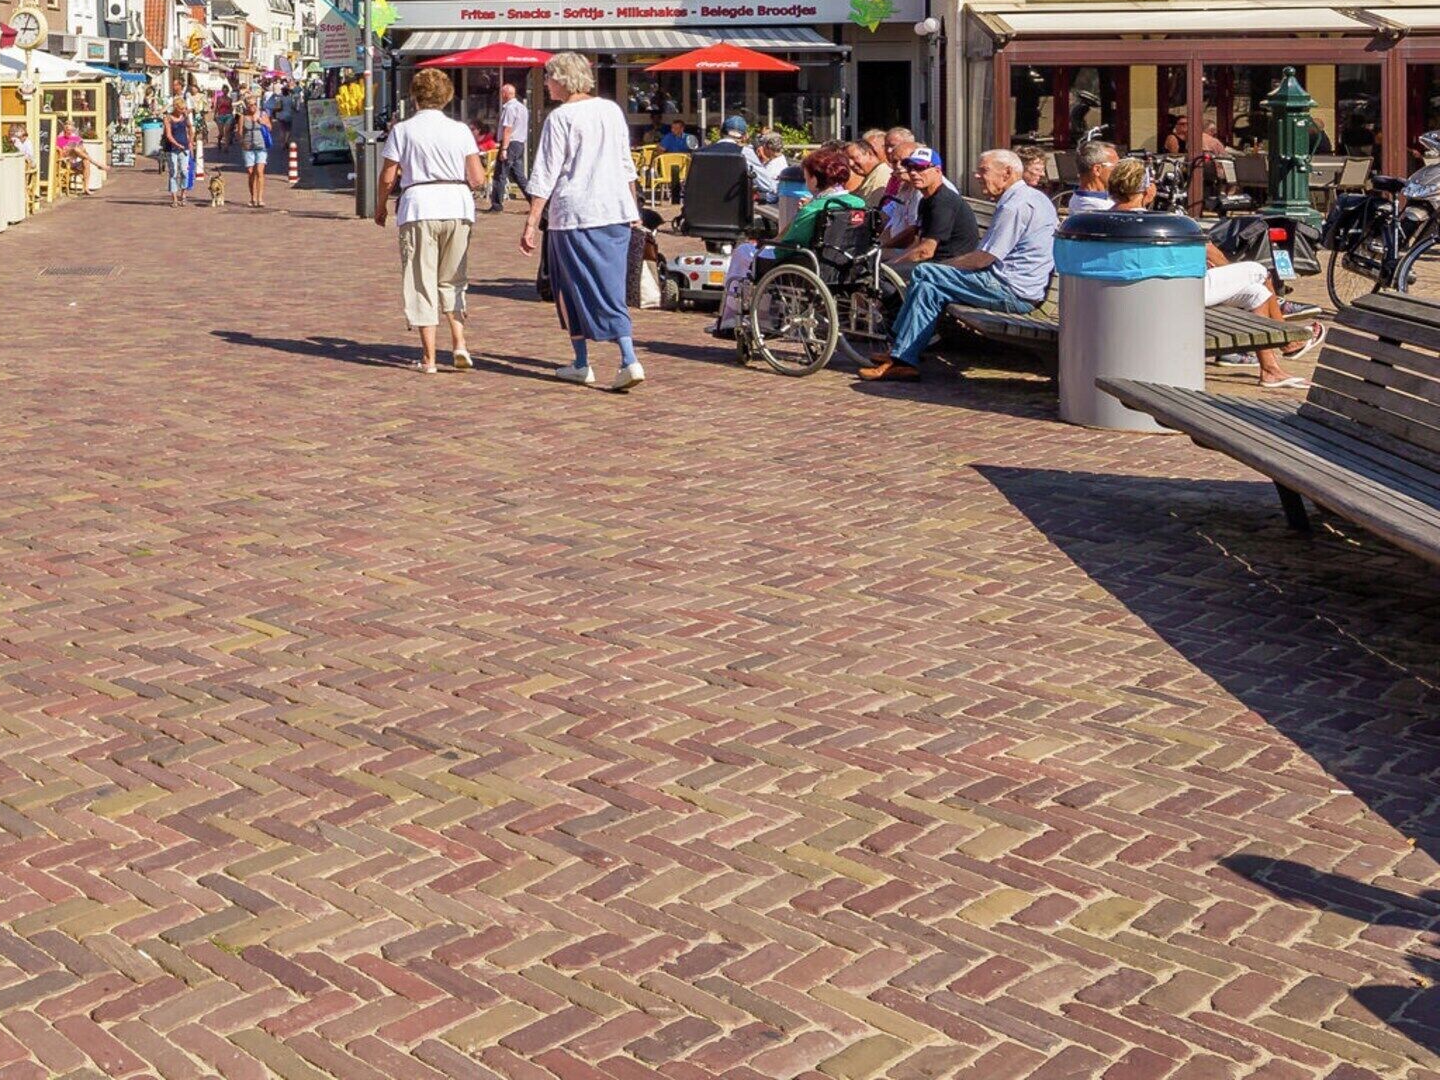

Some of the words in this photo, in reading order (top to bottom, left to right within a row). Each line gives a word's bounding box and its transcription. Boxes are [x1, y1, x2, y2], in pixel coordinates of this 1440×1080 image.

[461, 9, 496, 20] Frites
[507, 8, 552, 19] Snacks
[563, 7, 604, 21] Softijs
[616, 6, 688, 19] Milkshakes
[701, 5, 754, 19] Belegde
[757, 4, 817, 18] Broodjes
[319, 23, 346, 33] Stop!
